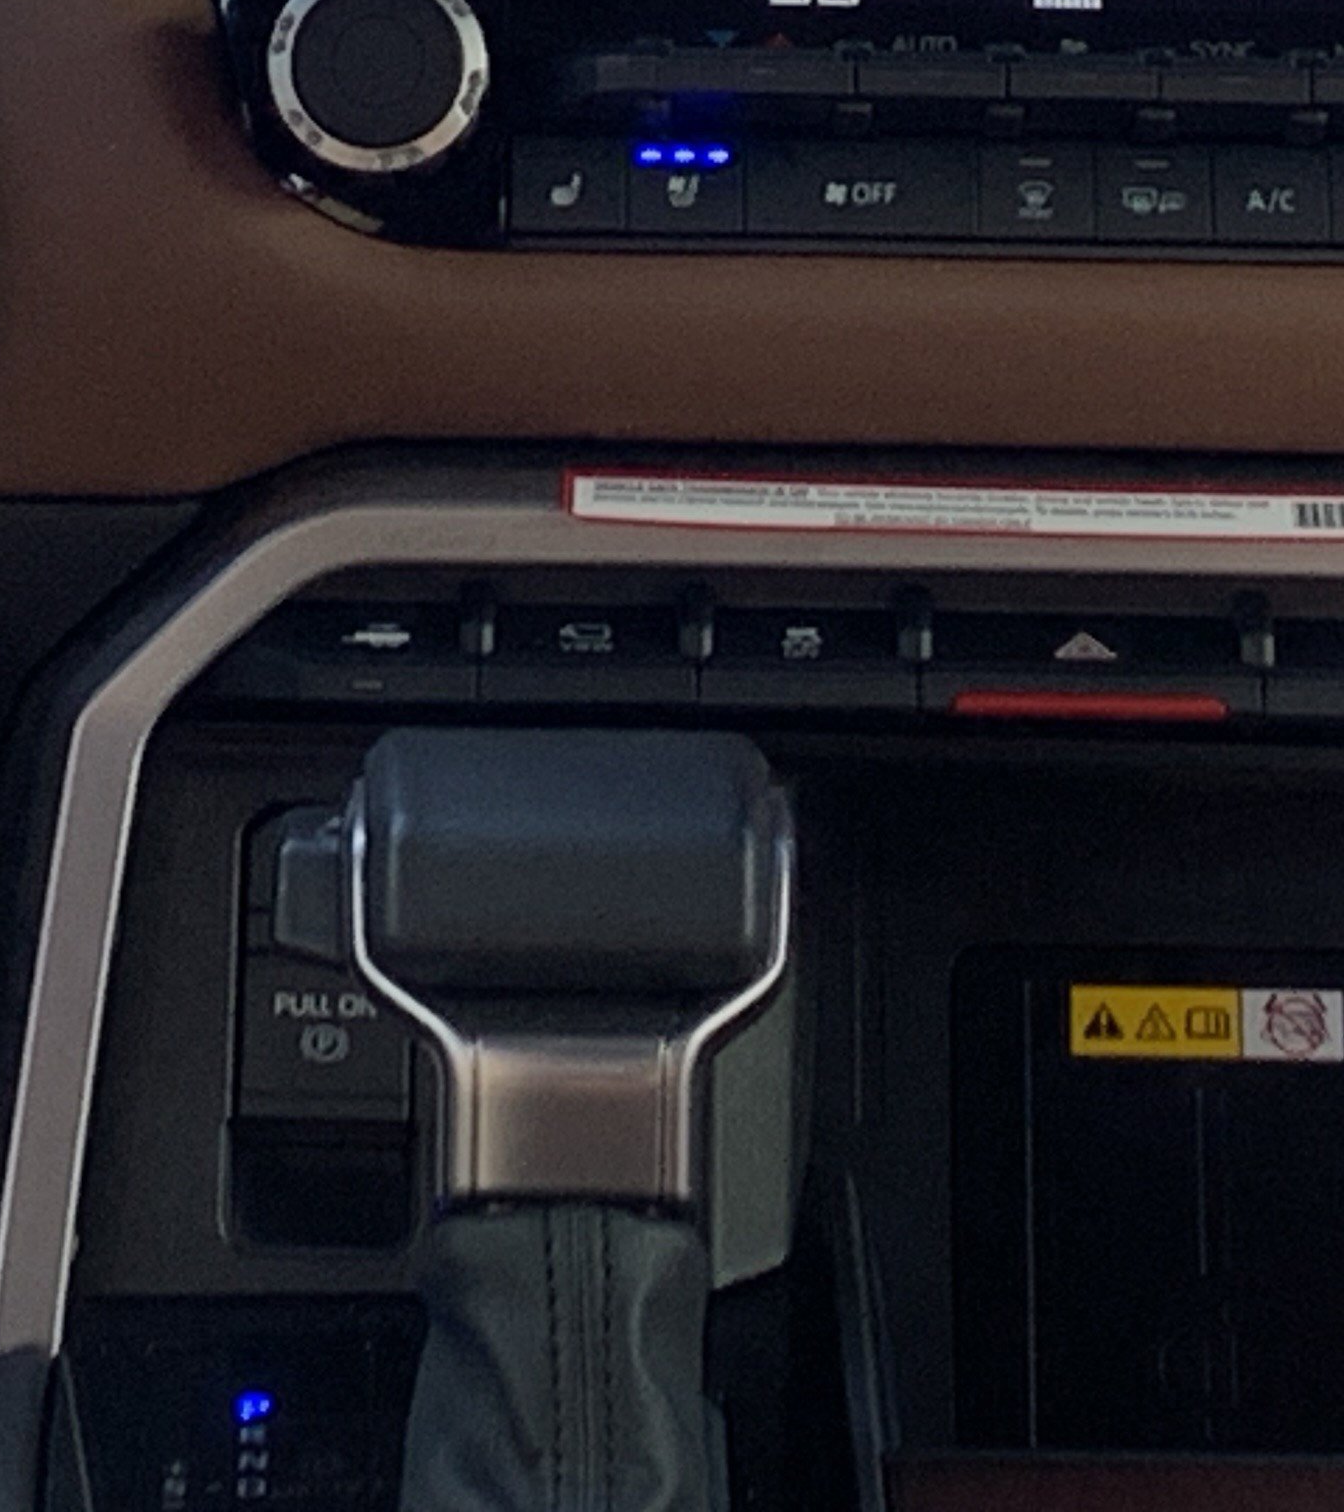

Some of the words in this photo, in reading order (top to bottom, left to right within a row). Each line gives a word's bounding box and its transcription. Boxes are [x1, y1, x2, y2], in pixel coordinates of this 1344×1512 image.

[892, 36, 959, 54] AUTO
[1190, 40, 1256, 59] SYNC
[851, 182, 897, 205] OFF
[1246, 188, 1295, 215] A/C
[274, 992, 330, 1017] PULL
